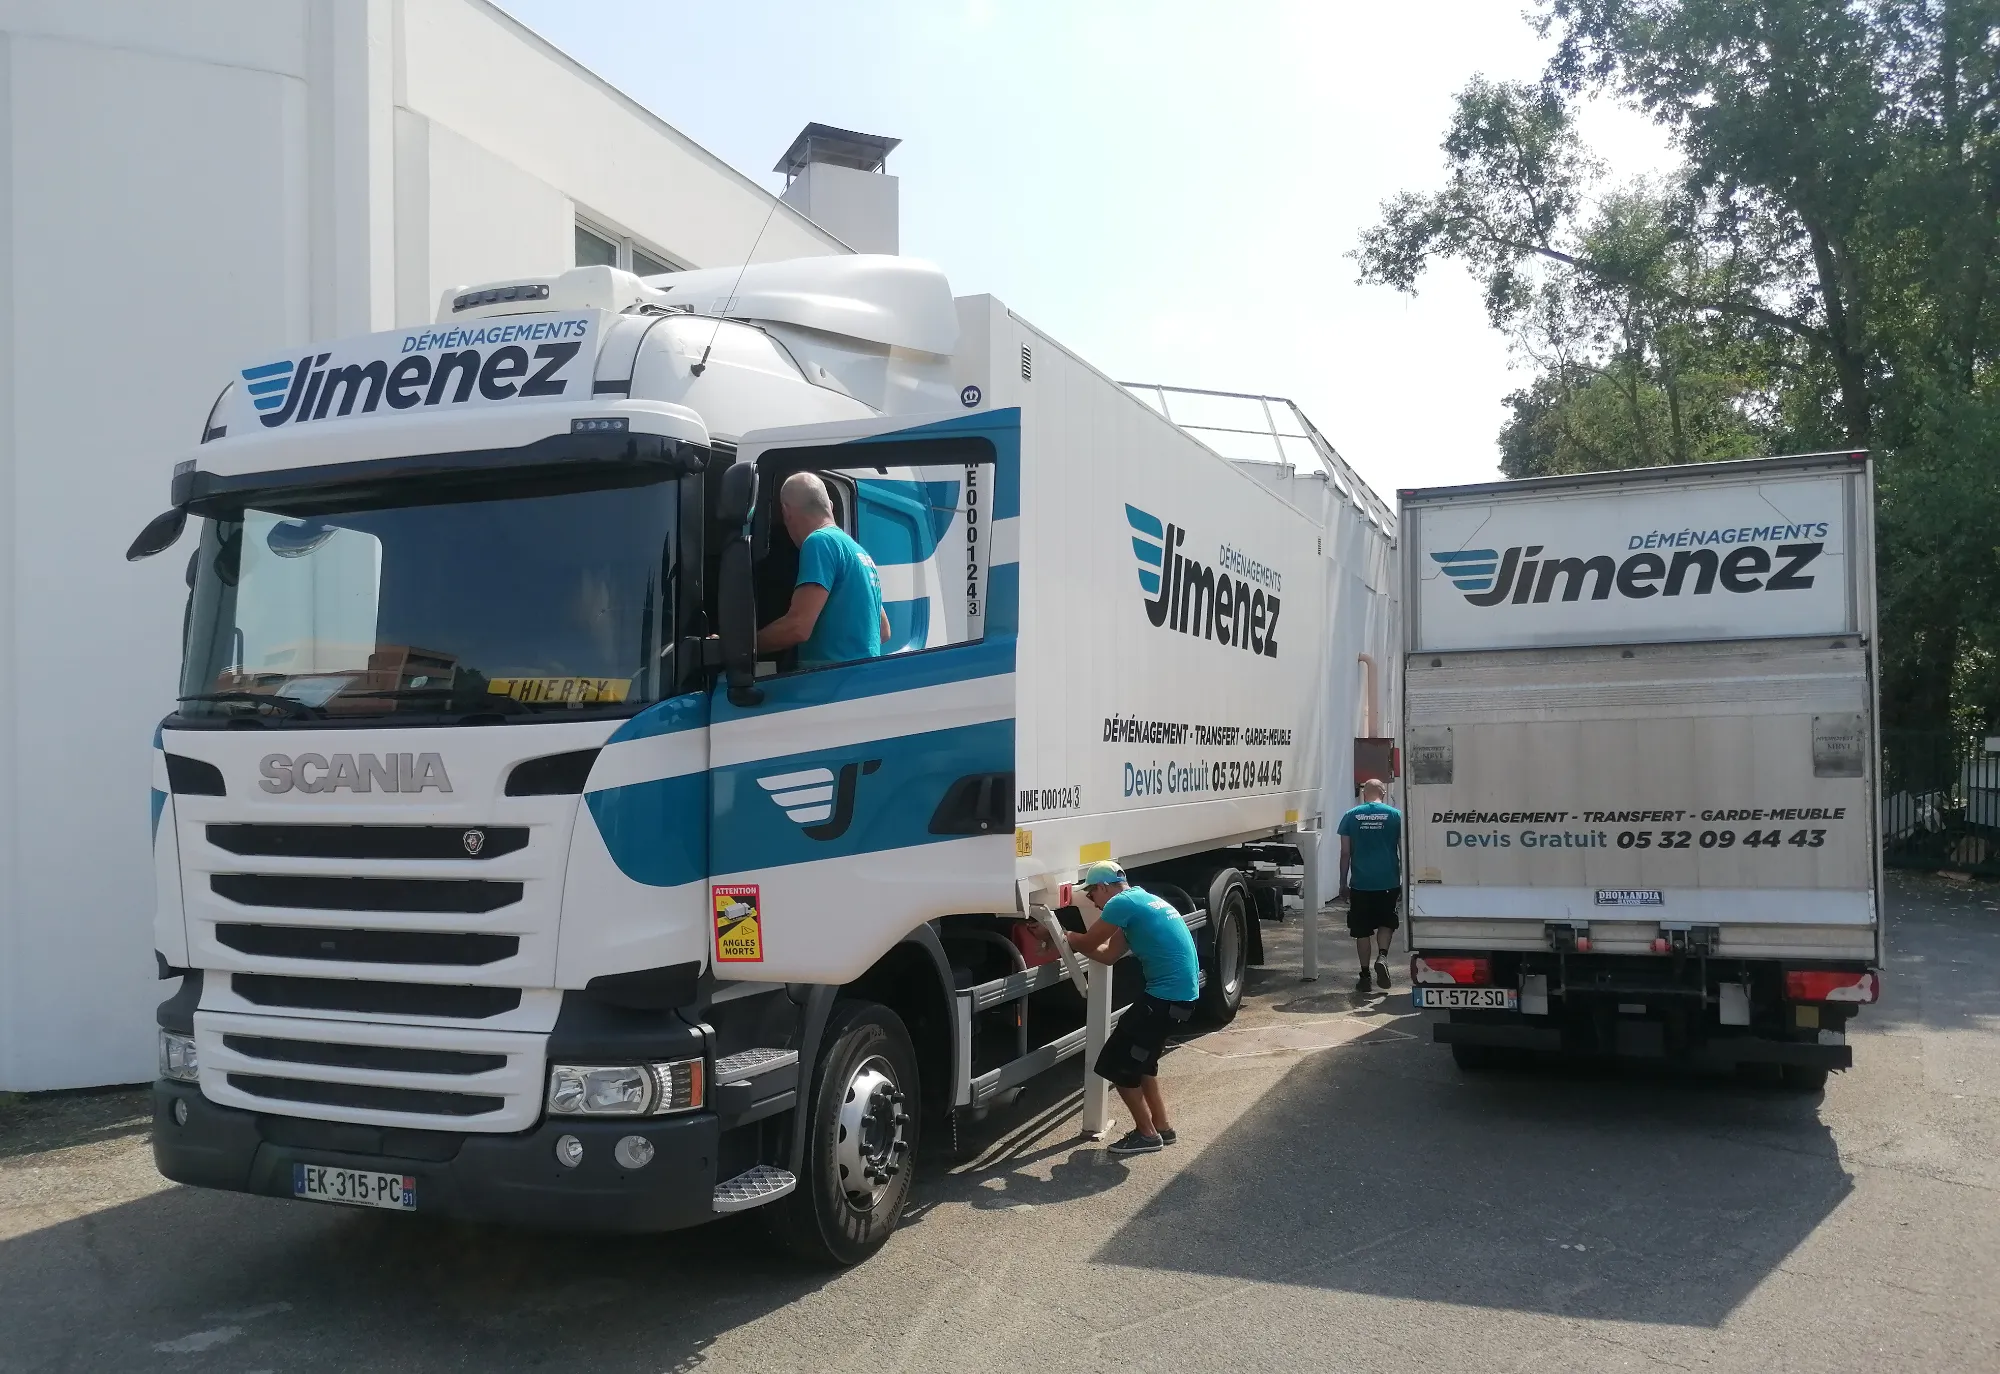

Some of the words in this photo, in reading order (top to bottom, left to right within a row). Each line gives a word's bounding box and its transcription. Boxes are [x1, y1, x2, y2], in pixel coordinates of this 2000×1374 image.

[401, 319, 588, 354] DÉMÉNAGEMENTS
[259, 341, 582, 428] Jimenez
[1628, 522, 1829, 551] DÉMÉNAGEMENTS
[1219, 542, 1282, 593] DÉMÉNAGEMENTS
[1463, 543, 1824, 607] Jimenez
[1144, 522, 1281, 659] Jimenez
[507, 679, 609, 701] THIERRY
[1103, 712, 1189, 745] DÉMÉNAGEMENT
[1195, 724, 1239, 746] TRANSFERT
[1245, 727, 1292, 746] GARDE-MEUBLE
[258, 752, 453, 794] SCANIA
[1124, 760, 1163, 797] Devis
[1167, 759, 1209, 794] Gratuit
[1212, 761, 1227, 791] 05
[1228, 761, 1241, 789] 32
[1243, 760, 1256, 788] 09
[1257, 760, 1270, 787] 44
[1271, 760, 1283, 786] 43
[1017, 789, 1039, 813] JIME
[1431, 809, 1568, 824] DÉMÉNAGEMENT
[1583, 810, 1687, 823] TRANSFERT
[1701, 808, 1847, 822] GARDE-MEUBLE
[1446, 830, 1511, 848] Devis
[1520, 830, 1608, 848] Gratuit
[1616, 831, 1653, 849] 05
[1657, 830, 1693, 849] 32
[1698, 830, 1736, 849] 09
[1742, 829, 1782, 848] 44
[1788, 829, 1828, 848] 43
[1598, 891, 1660, 900] DHOLLANDIA
[725, 948, 755, 956] MORTS
[1425, 990, 1505, 1006] CT-572-SQ
[307, 1168, 401, 1202] EK-315-PC
[403, 1192, 414, 1205] 31
